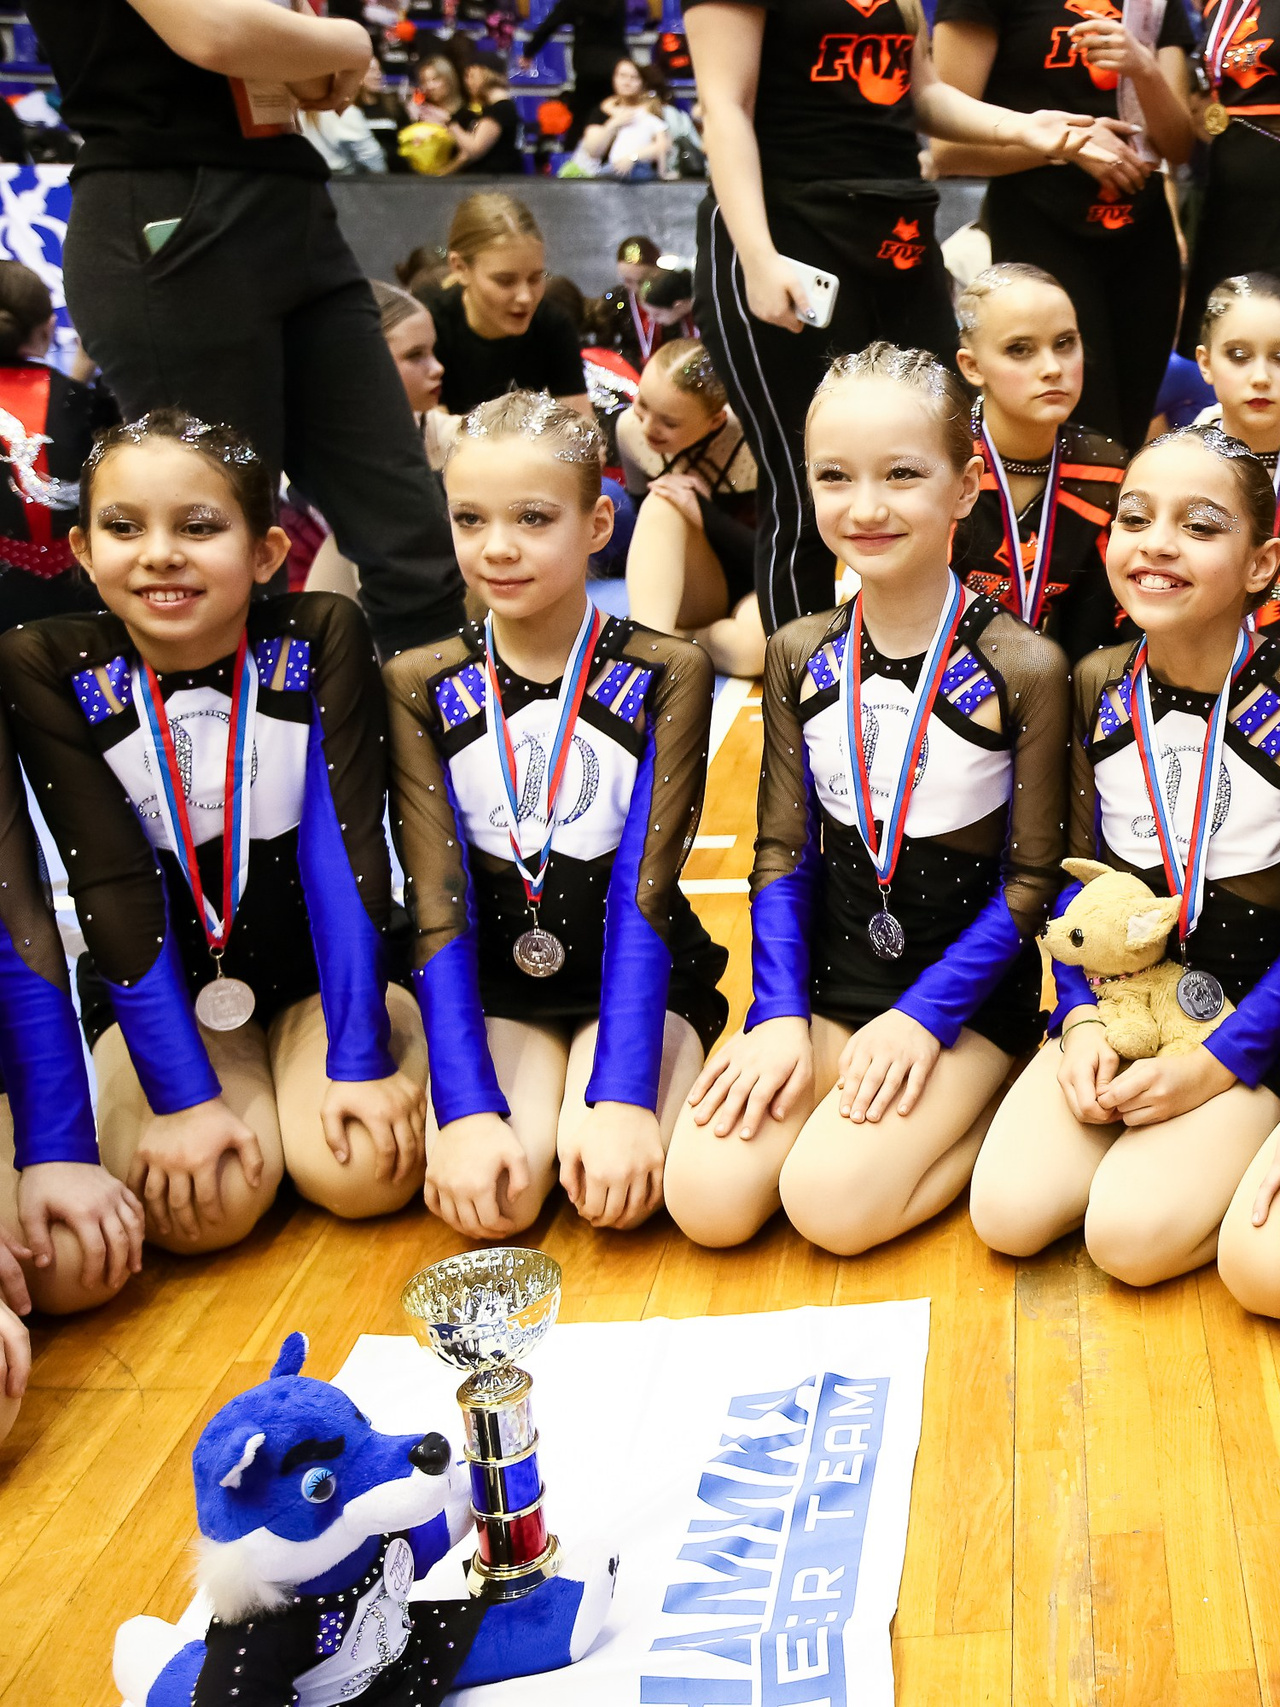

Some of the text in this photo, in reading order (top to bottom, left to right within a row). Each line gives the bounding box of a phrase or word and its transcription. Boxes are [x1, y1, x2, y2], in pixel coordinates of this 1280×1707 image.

[810, 33, 915, 96] FOX
[876, 240, 926, 266] FOX
[803, 1383, 878, 1533] TEAM
